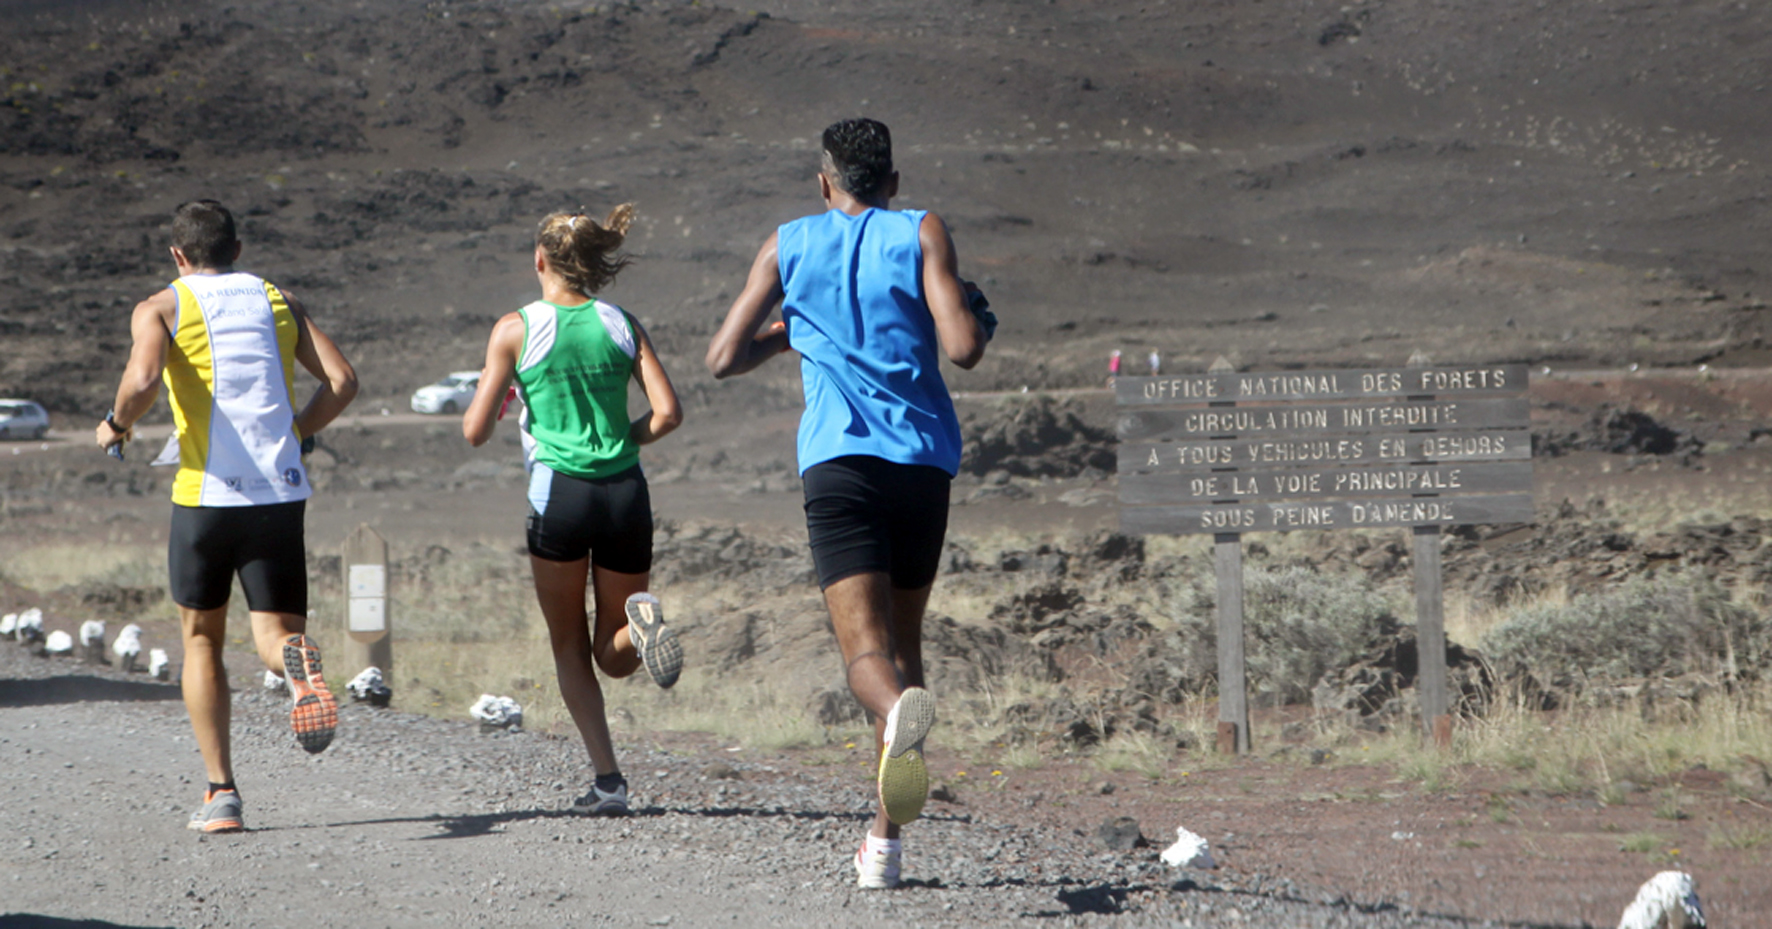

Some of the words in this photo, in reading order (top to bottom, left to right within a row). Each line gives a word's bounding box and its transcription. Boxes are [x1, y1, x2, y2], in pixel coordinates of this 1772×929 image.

[1144, 378, 1218, 399] OFFICE
[1239, 375, 1344, 396] NATIONAL
[1362, 373, 1402, 393] DES
[1421, 369, 1506, 390] FORETS
[1185, 410, 1327, 432] CIRCULATION
[1343, 404, 1458, 427] INTERDITE
[1147, 448, 1160, 466] A
[1177, 446, 1233, 465] TOUS
[1248, 440, 1363, 462] VEHICULES
[1379, 438, 1406, 458] EN
[1422, 435, 1506, 457] DEHORS
[1191, 477, 1219, 497] DE
[1233, 476, 1259, 495] LA
[1274, 473, 1321, 494] VOIE
[1335, 469, 1462, 491] PRINCIPALE
[1201, 508, 1255, 528] SOUS
[1272, 506, 1334, 526] PEINE
[1352, 501, 1454, 524] D'AMENDE
